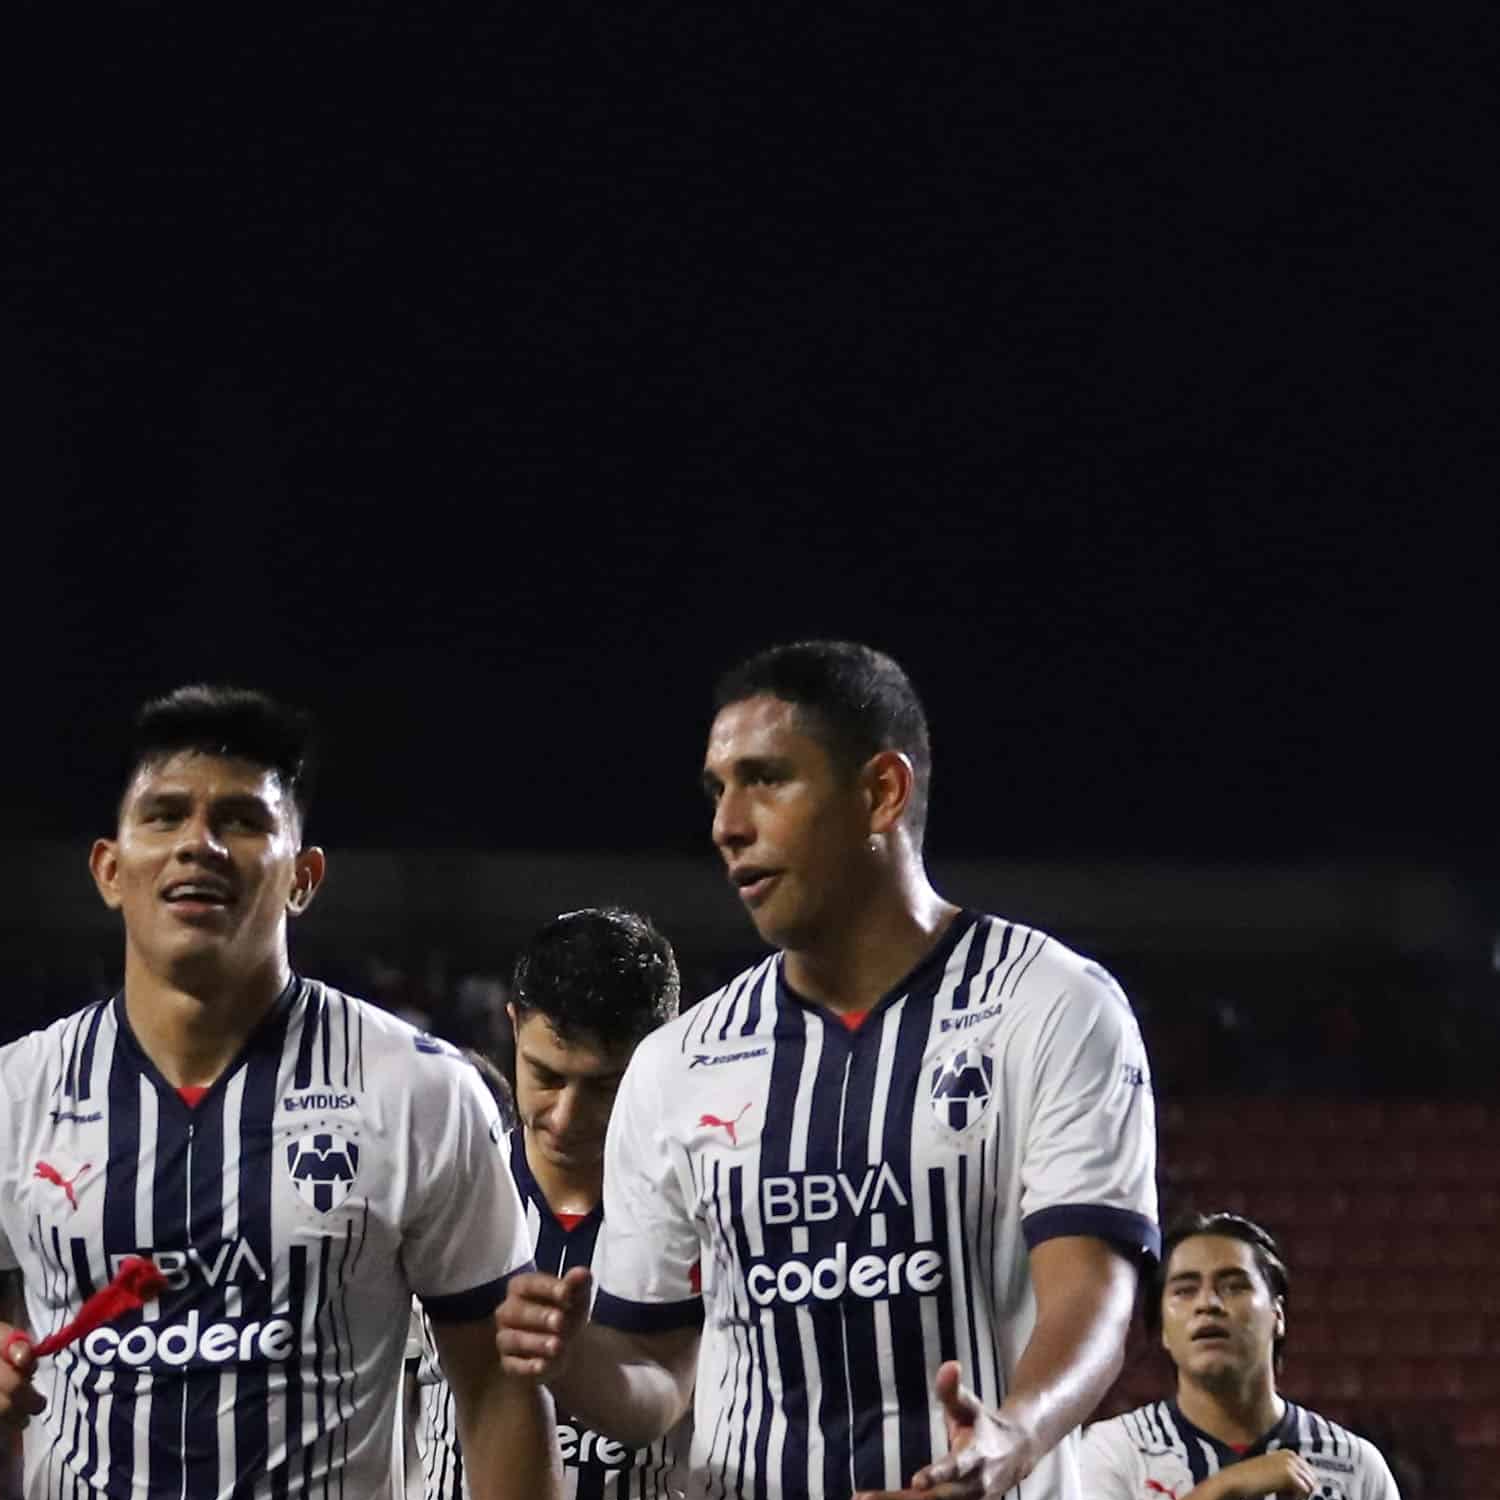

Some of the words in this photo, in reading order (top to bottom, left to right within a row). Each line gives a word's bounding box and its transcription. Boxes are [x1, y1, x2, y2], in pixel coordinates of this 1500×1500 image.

[762, 1163, 908, 1225] BBVA
[109, 1237, 267, 1291] BVA
[747, 1241, 944, 1303] codere
[83, 1309, 294, 1366] codere
[556, 1424, 628, 1465] ere
